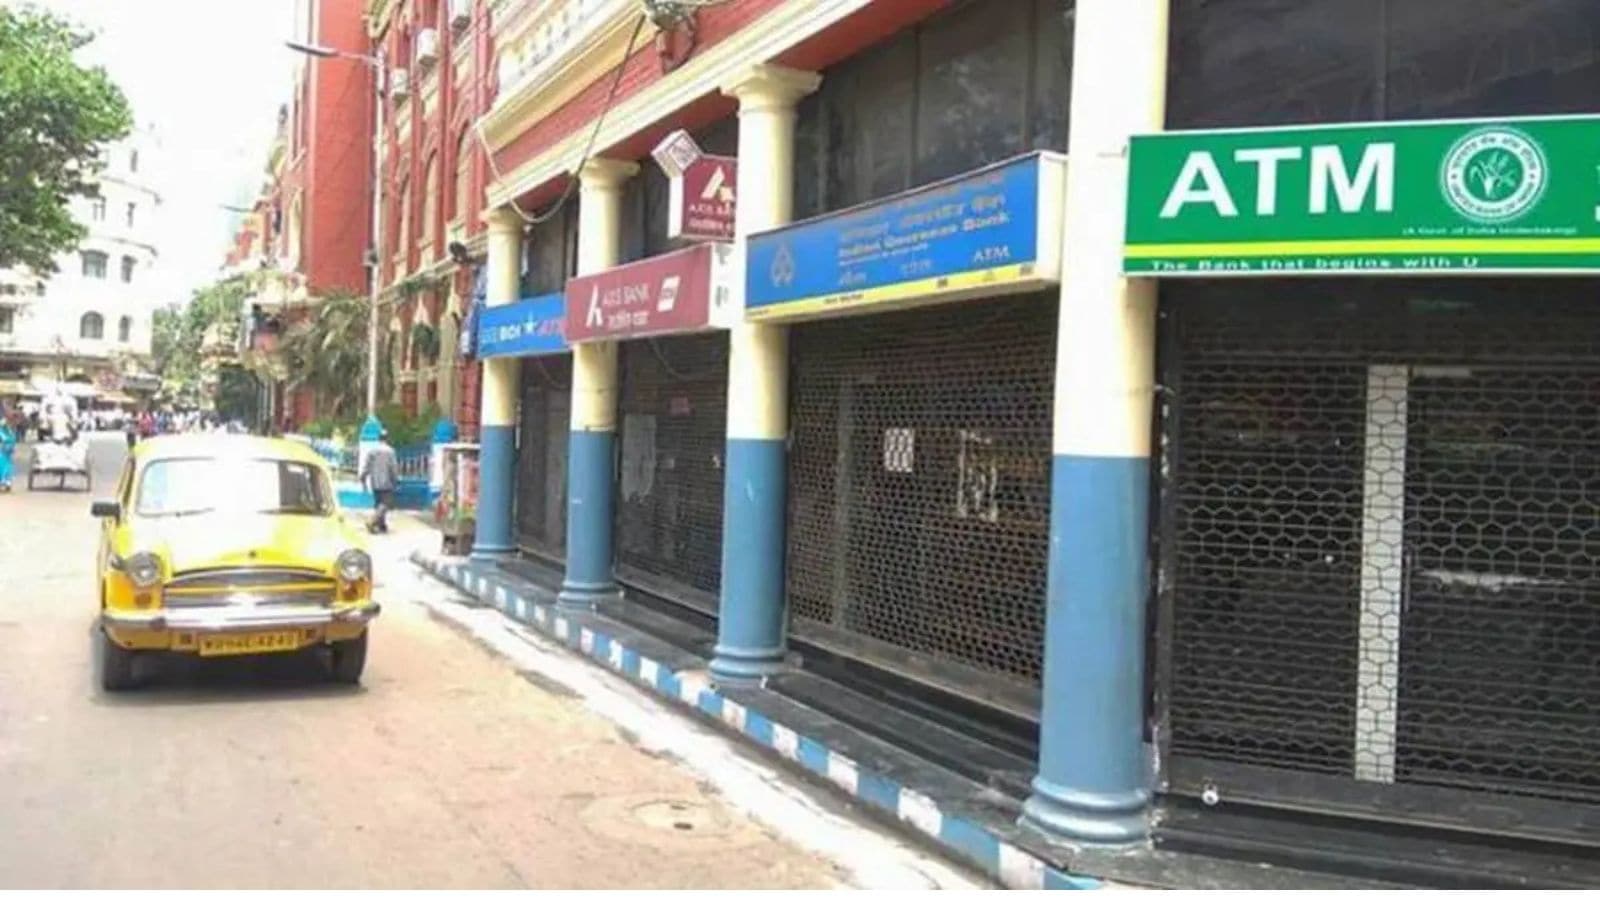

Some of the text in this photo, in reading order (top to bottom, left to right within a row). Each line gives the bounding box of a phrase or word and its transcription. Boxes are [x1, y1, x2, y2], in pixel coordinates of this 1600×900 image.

[1158, 141, 1397, 219] ATM
[962, 210, 1010, 232] Bank
[973, 244, 1011, 263] ATM
[1152, 259, 1188, 271] The
[1199, 259, 1249, 271] Bank
[1262, 258, 1303, 270] that
[1315, 257, 1391, 271] begins
[1402, 256, 1451, 268] with
